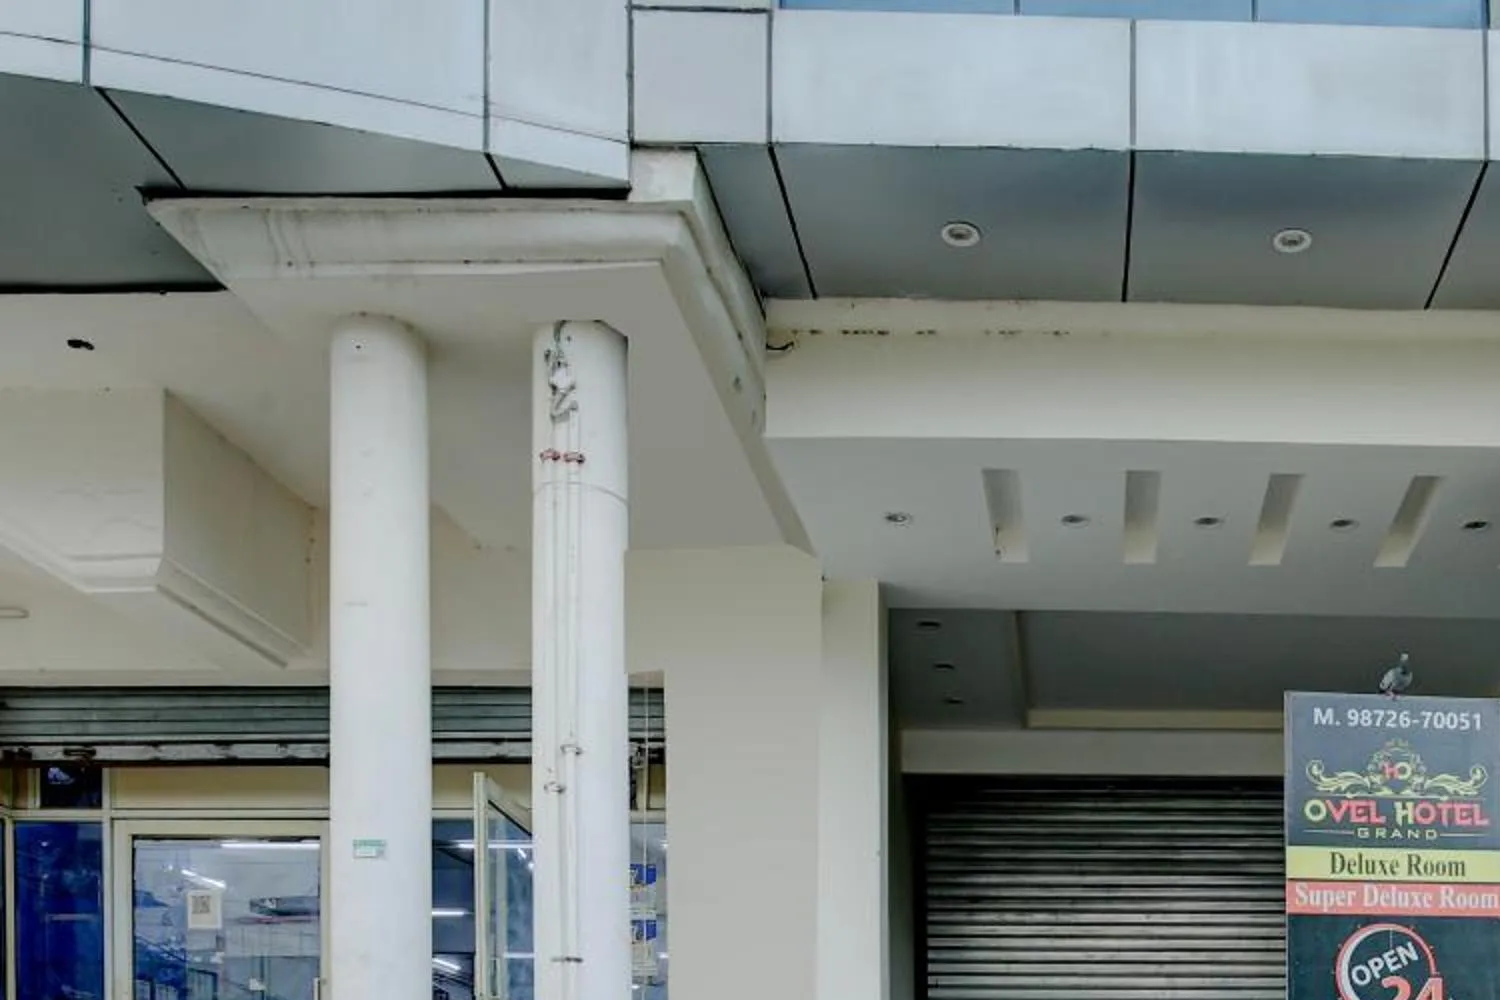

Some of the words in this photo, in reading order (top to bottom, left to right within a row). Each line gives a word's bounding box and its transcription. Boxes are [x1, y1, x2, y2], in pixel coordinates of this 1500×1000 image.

[1313, 707, 1341, 726] M.
[1347, 709, 1482, 730] 98726-70051
[1304, 799, 1386, 824] OVEL
[1395, 801, 1490, 827] HOTEL
[1357, 828, 1438, 840] GRAND
[1330, 851, 1400, 877] Deluxe
[1406, 853, 1466, 877] Room
[1295, 883, 1355, 914] Super
[1363, 884, 1433, 909] Deluxe
[1439, 886, 1499, 910] Room
[1351, 941, 1419, 986] OPEN
